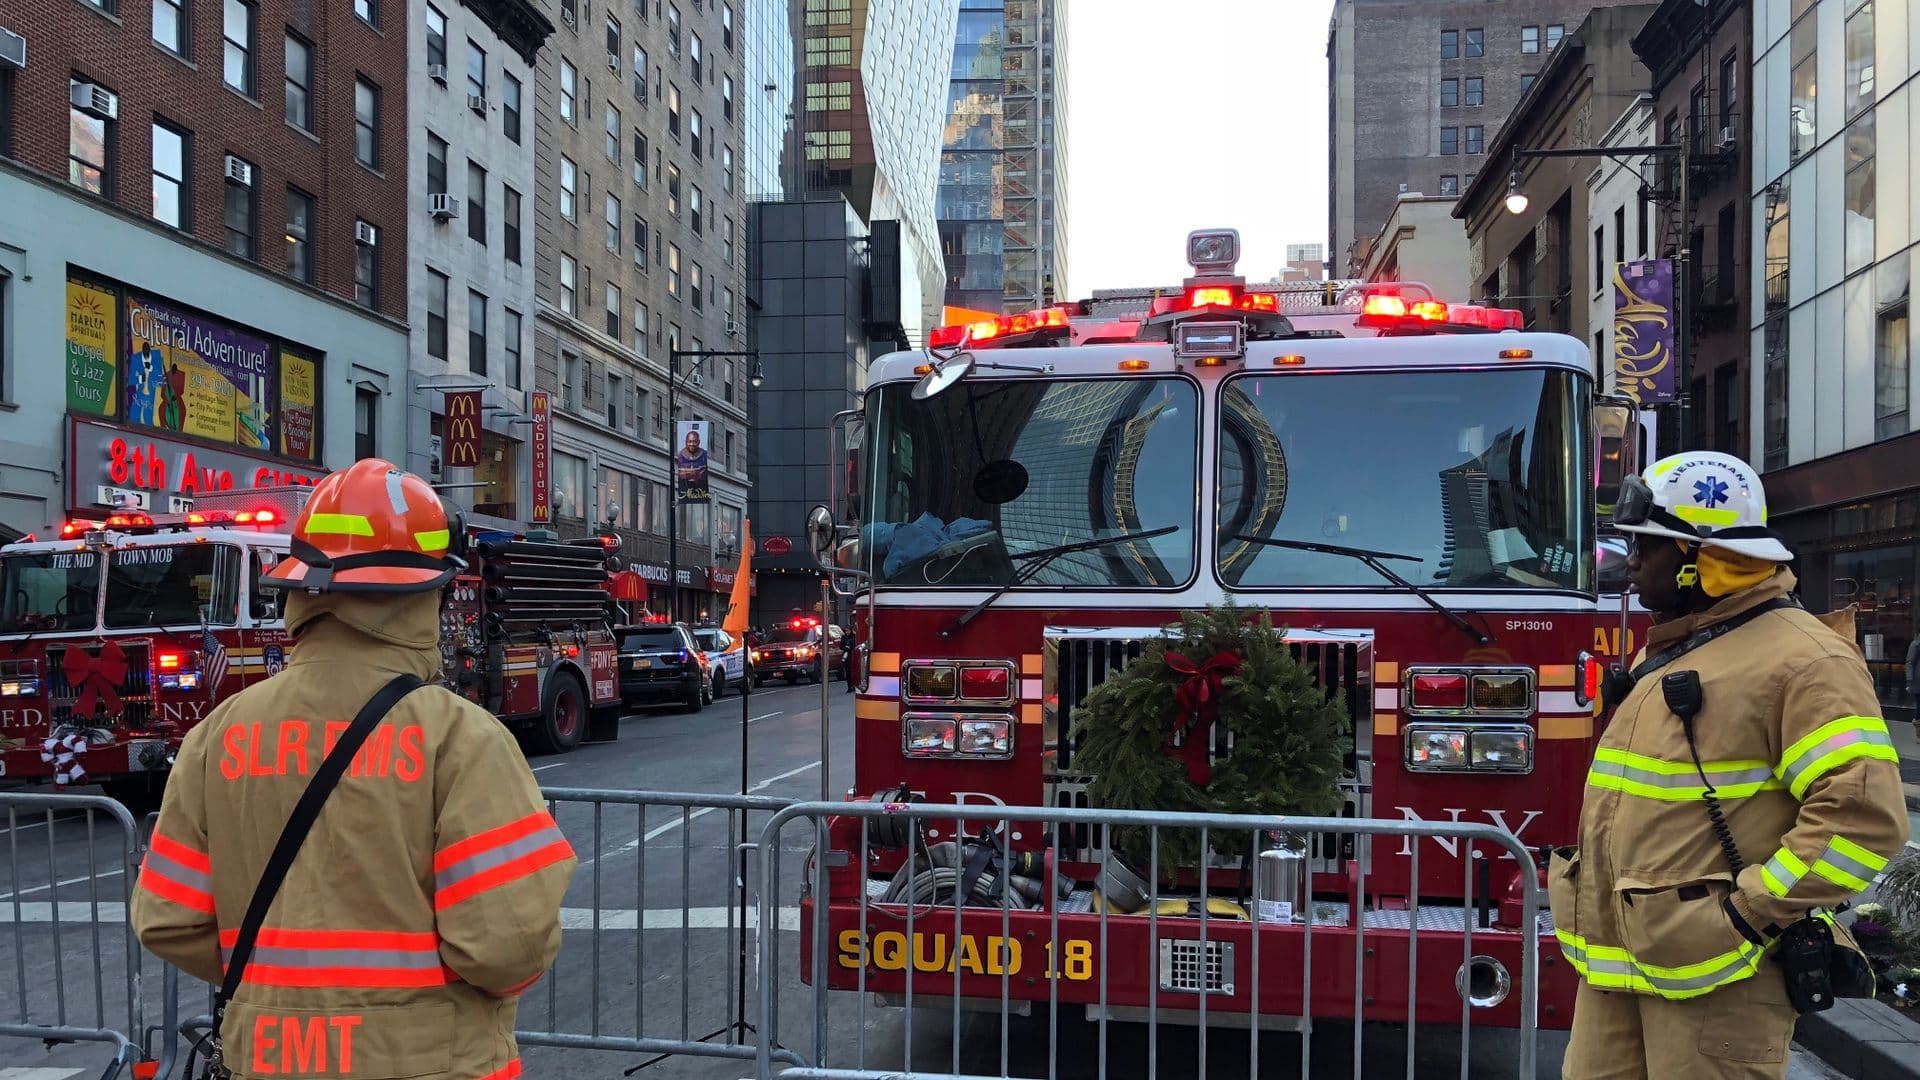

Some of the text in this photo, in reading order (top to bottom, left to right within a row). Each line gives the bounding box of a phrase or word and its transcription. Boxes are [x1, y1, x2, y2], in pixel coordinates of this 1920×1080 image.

[71, 311, 106, 331] HARLEM
[144, 304, 187, 328] Embark on a
[71, 324, 106, 341] SPIRITUALS
[130, 308, 191, 351] Cultural
[69, 337, 105, 363] Gospel
[71, 358, 105, 382] & Jazz
[73, 380, 102, 402] Tours
[290, 436, 305, 451] Tours
[110, 437, 166, 491] 8th
[180, 452, 234, 493] Ave
[535, 413, 546, 501] McDonald's
[1668, 460, 1750, 491] LIEUTENANT
[52, 553, 94, 569] THE MID
[117, 547, 174, 566] TOWN MOB
[630, 562, 669, 582] STARBUCKS
[1505, 620, 1553, 631] SP13010
[593, 650, 612, 669] FDNY
[1, 708, 48, 728] F.D.
[219, 720, 309, 781] SLR
[838, 929, 1092, 981] SQUAD 18
[253, 1014, 362, 1074] EMT
